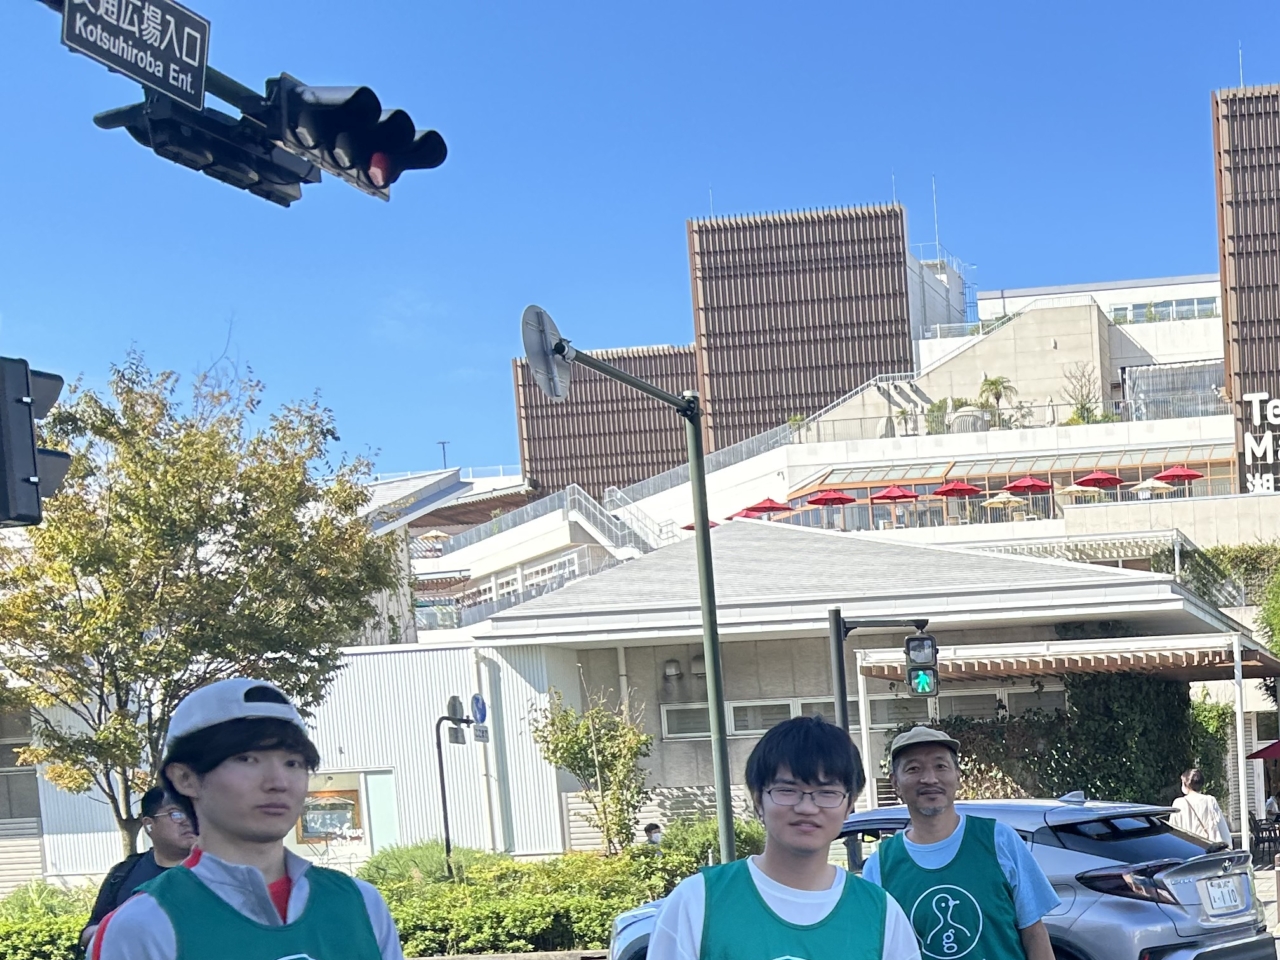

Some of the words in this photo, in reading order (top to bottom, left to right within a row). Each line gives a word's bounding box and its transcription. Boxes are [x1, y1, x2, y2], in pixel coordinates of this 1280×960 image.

[74, 0, 200, 67] 通広場入口
[75, 12, 164, 78] Kotsuhiroba
[168, 63, 196, 95] Ent.
